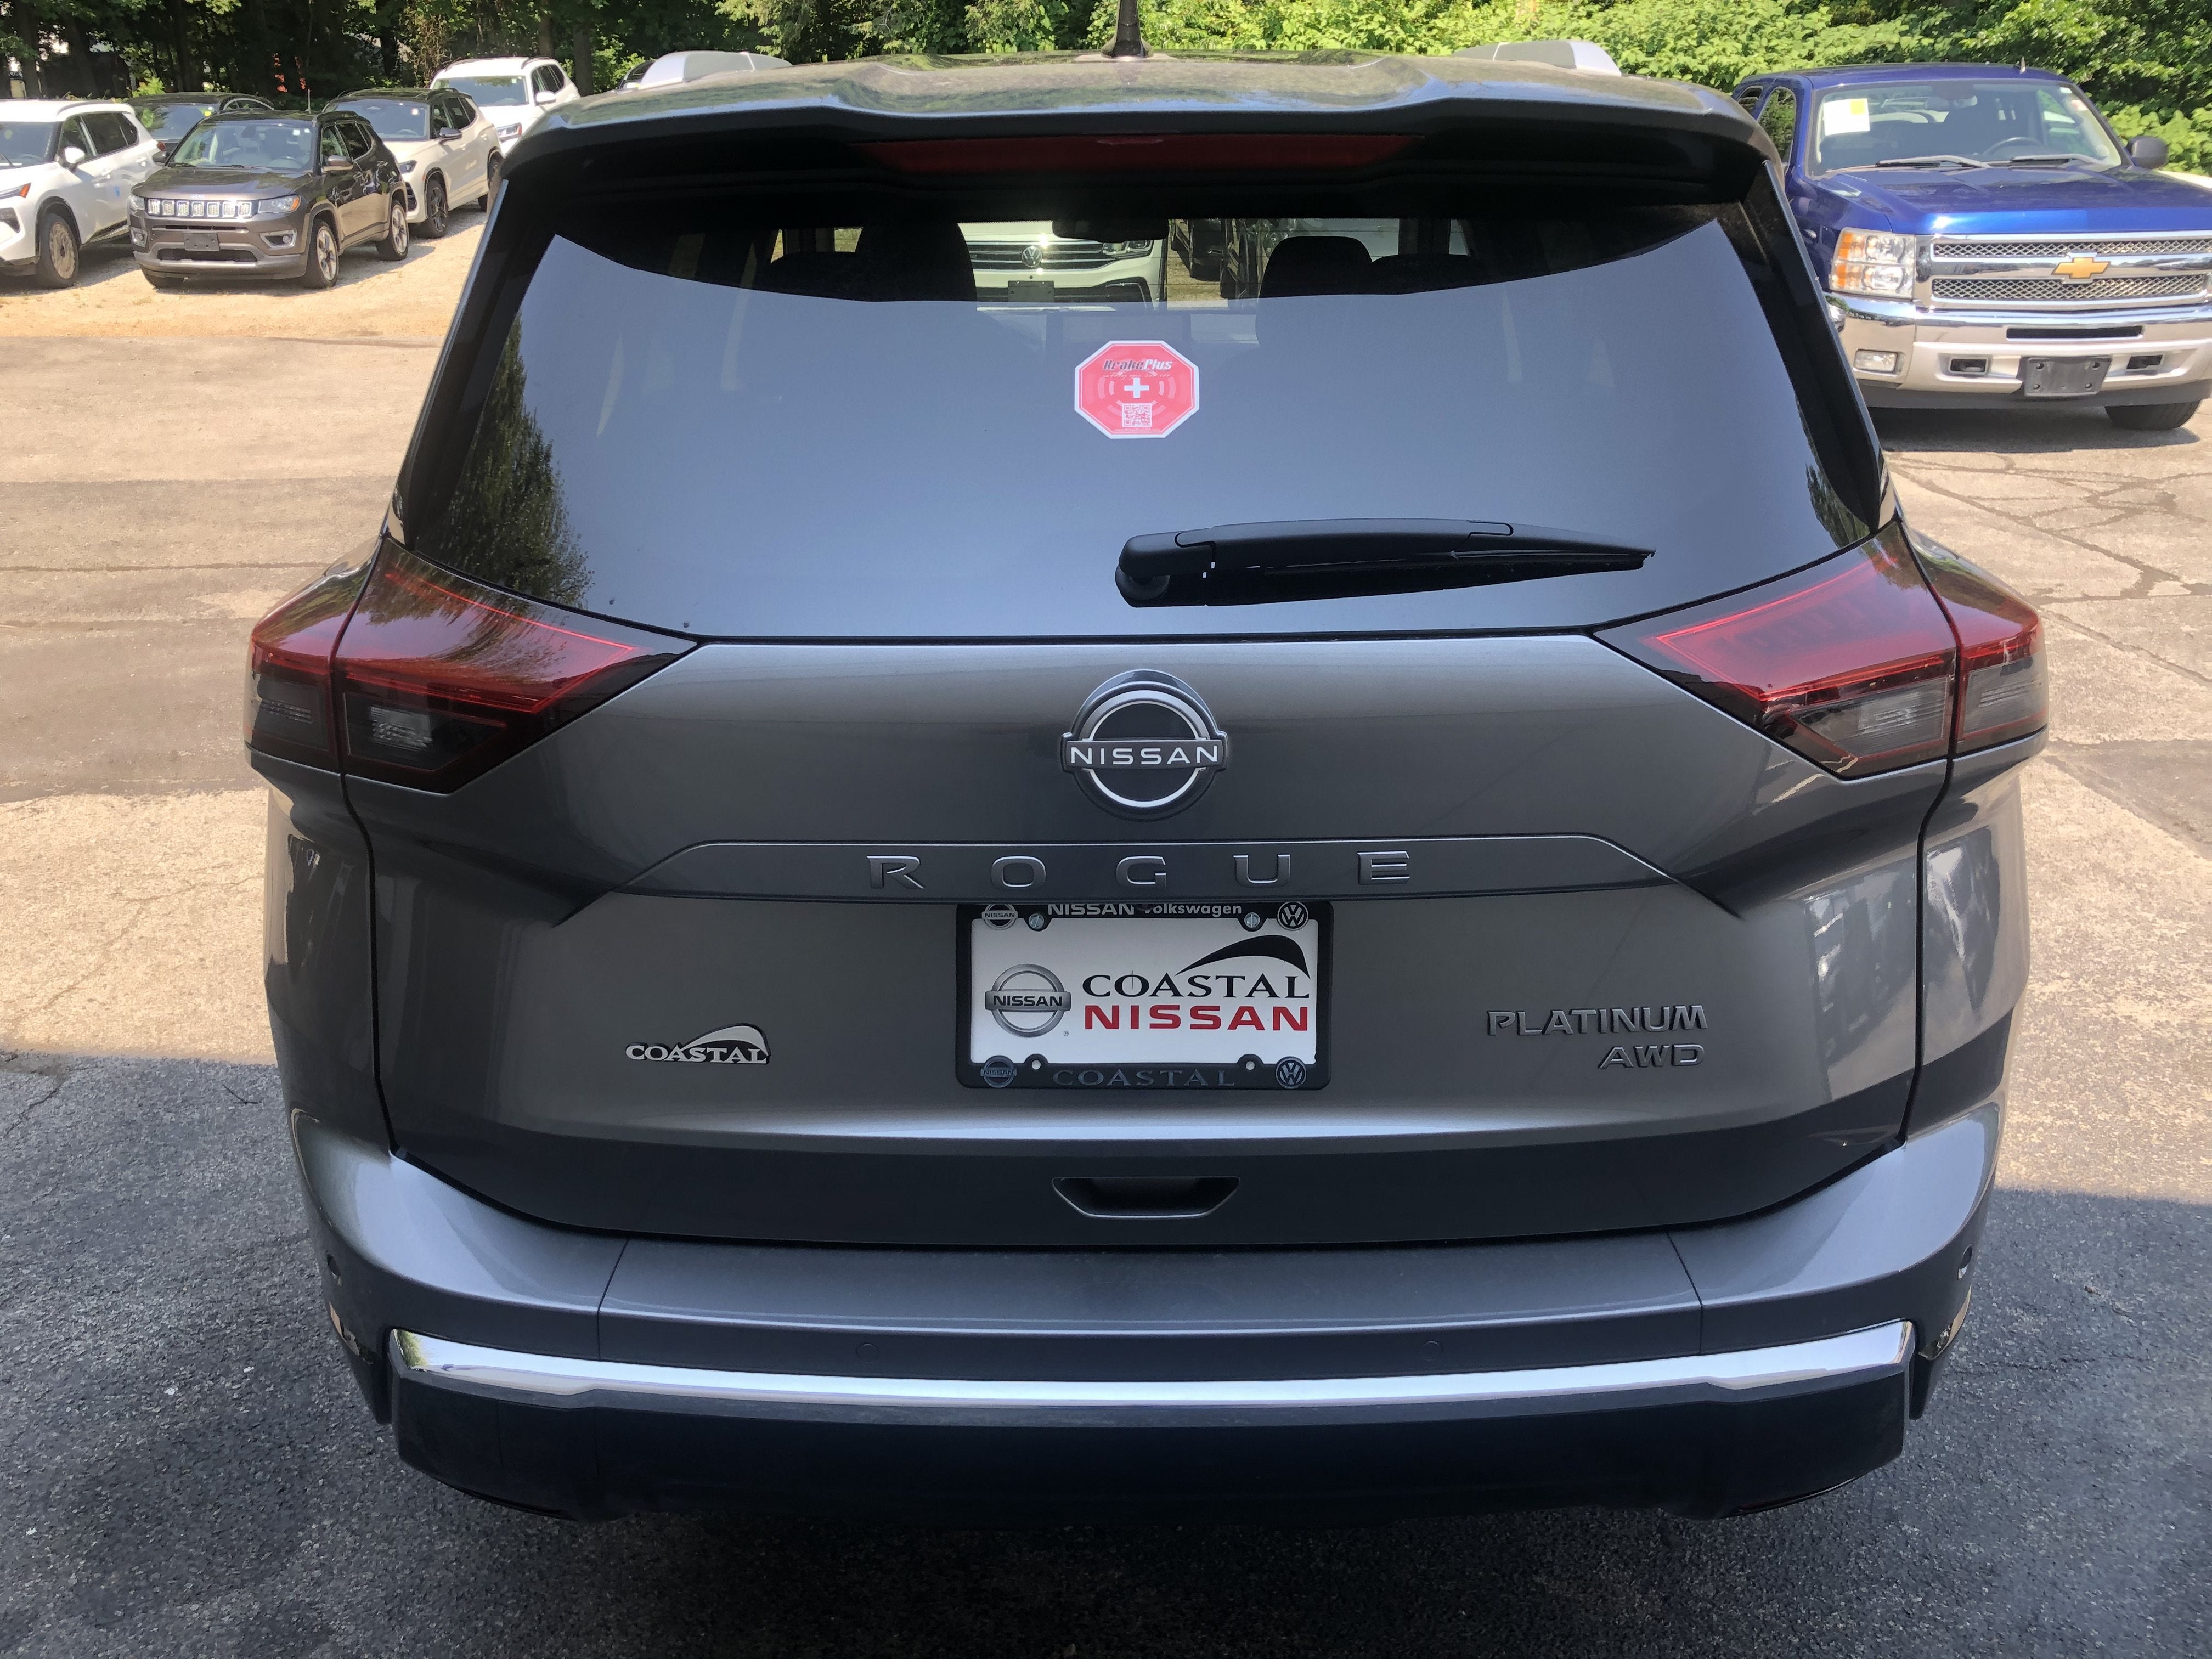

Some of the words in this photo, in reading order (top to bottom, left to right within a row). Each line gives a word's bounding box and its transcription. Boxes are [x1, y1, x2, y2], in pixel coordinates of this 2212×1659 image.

[1103, 359, 1173, 370] BrakePlus
[1070, 745, 1218, 765] NISSAN
[866, 851, 1410, 889] ROGUE
[1048, 903, 1135, 915] NISSAN
[1144, 903, 1242, 917] olkswagen
[1082, 972, 1311, 999] COASTAL
[994, 995, 1063, 1007] NISSAN
[1084, 1005, 1308, 1031] NISSAN
[1487, 1005, 1708, 1036] PLATINUM
[625, 1045, 767, 1064] COASTAL
[1598, 1044, 1705, 1069] AWD
[1052, 1069, 1234, 1086] COASTAL
